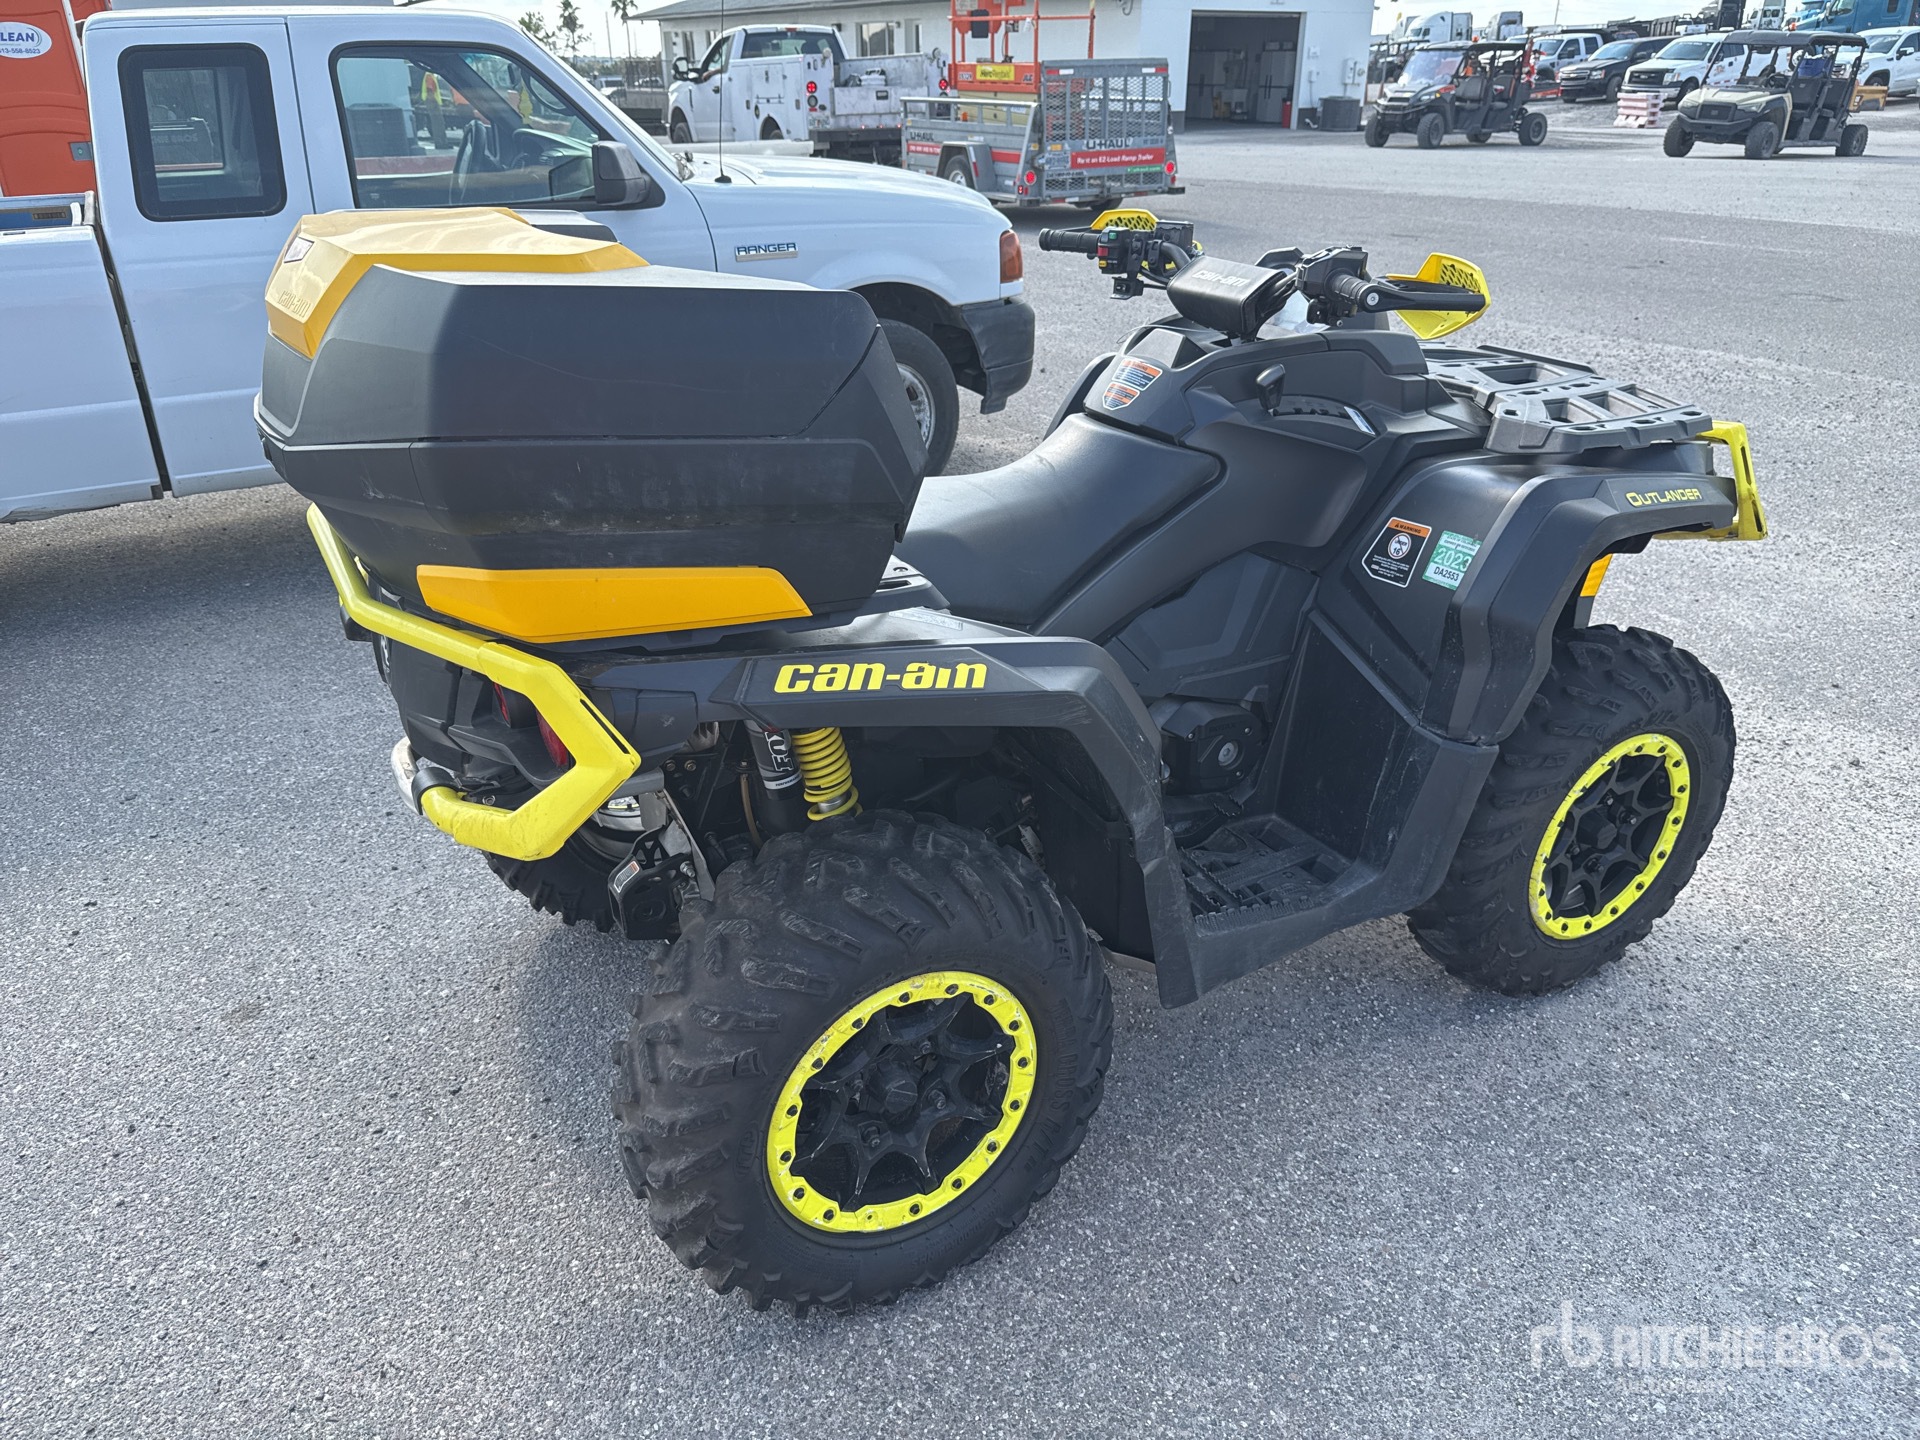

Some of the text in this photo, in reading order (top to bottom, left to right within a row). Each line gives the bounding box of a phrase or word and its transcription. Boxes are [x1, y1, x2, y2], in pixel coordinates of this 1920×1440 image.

[1086, 138, 1131, 150] U-HAUL
[737, 242, 797, 255] RANGER
[1434, 547, 1472, 572] 2023
[1433, 566, 1460, 581] DA2553
[774, 662, 988, 693] can-am
